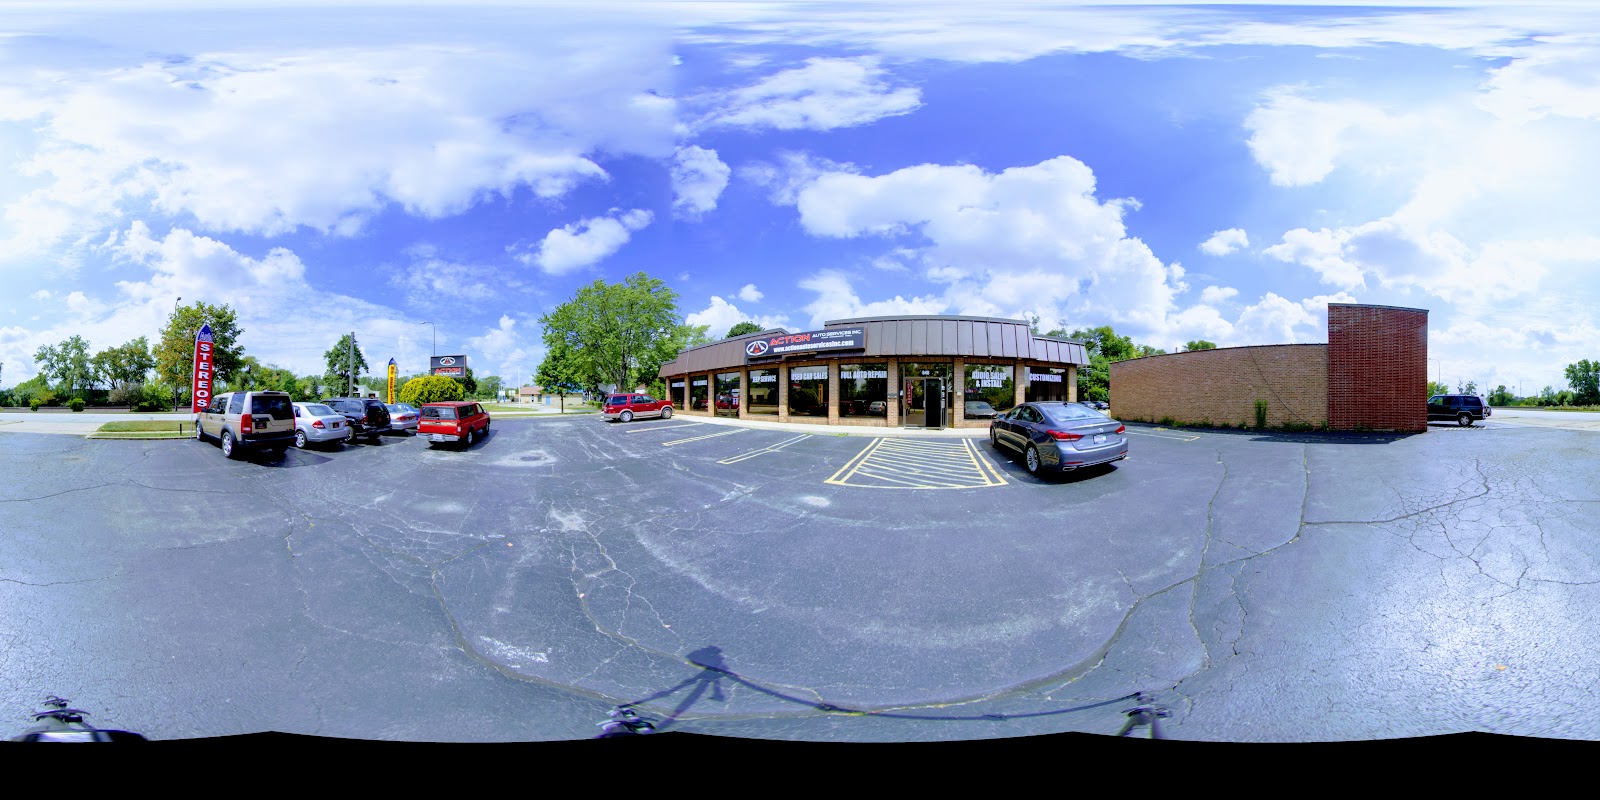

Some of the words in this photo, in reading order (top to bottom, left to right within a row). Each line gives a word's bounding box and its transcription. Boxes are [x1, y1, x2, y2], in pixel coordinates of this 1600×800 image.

[769, 334, 810, 345] ACTION
[196, 343, 210, 408] STEREOS
[791, 373, 802, 381] USED
[803, 372, 813, 380] CAR
[814, 371, 828, 380] SALES
[841, 371, 852, 379] FULL
[853, 370, 867, 379] AUTO
[868, 370, 887, 379] REPAIR
[972, 371, 989, 380] AUDIO
[991, 372, 1007, 380] SALES
[1030, 373, 1061, 382] CUSTOMIZING
